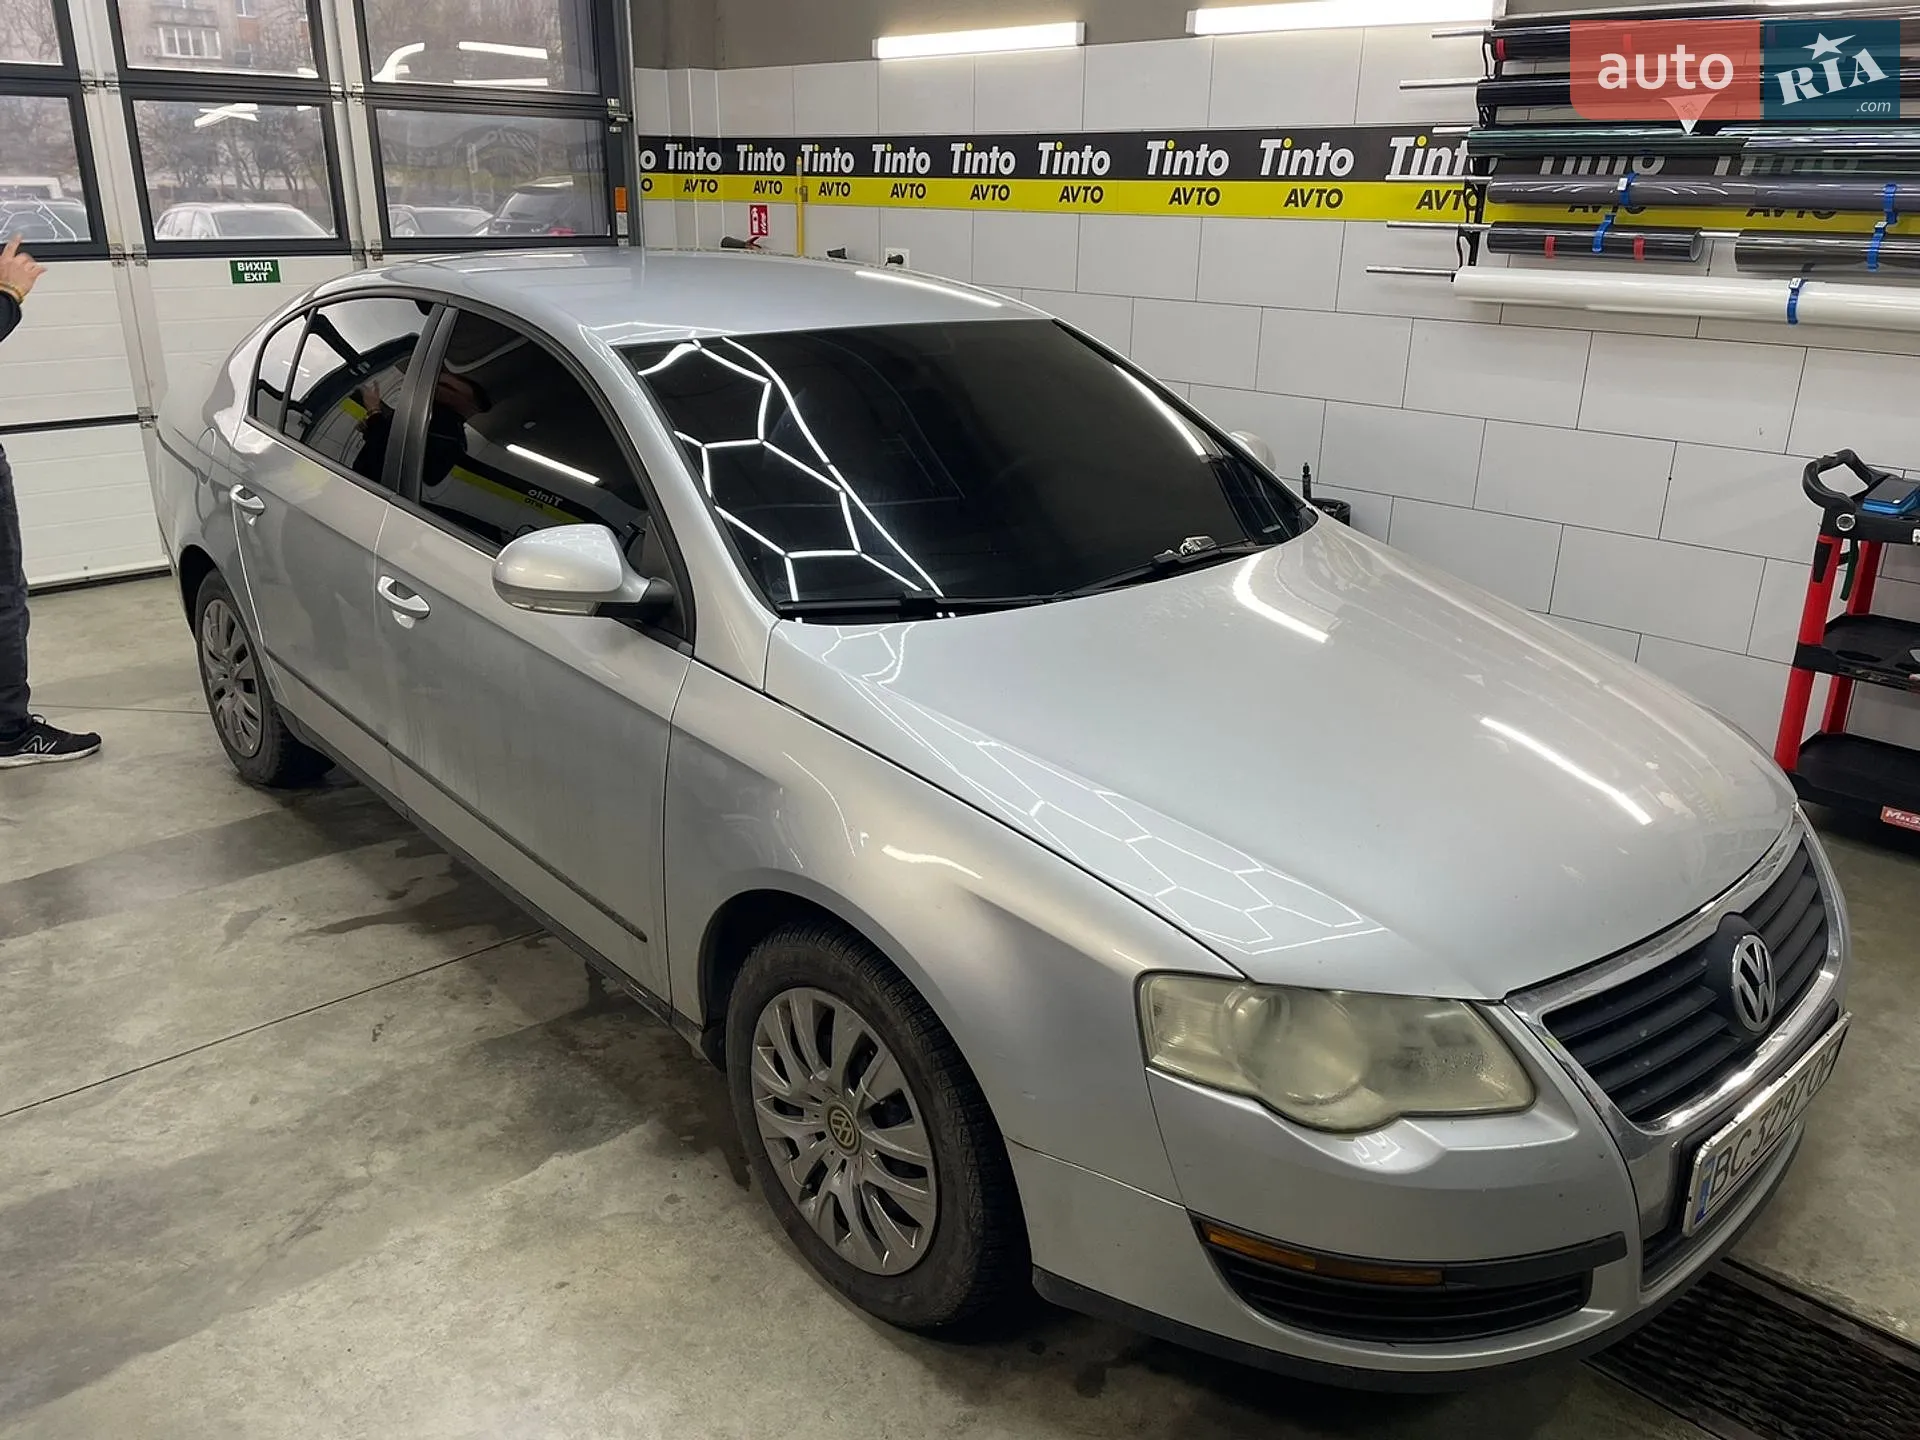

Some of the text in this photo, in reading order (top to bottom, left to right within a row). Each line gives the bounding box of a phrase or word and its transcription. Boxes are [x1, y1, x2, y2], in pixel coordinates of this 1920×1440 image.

[666, 143, 722, 171] Tinto
[736, 143, 786, 173] Tinto
[801, 143, 855, 174] Tinto
[871, 143, 931, 174] Tinto
[950, 142, 1016, 175] Tinto
[1037, 141, 1111, 176] Tinto
[1146, 139, 1230, 177] Tinto
[1259, 137, 1355, 177] Tinto
[683, 178, 719, 194] AVTO
[753, 180, 783, 195] AVTO
[817, 181, 851, 197] AVTO
[889, 182, 927, 200] AVTO
[969, 184, 1011, 202] AVTO
[1058, 185, 1104, 204] AVTO
[1168, 187, 1221, 207] AVTO
[1283, 188, 1344, 209] AVTO
[237, 261, 273, 271] ВИХІД
[243, 272, 268, 281] EXIT
